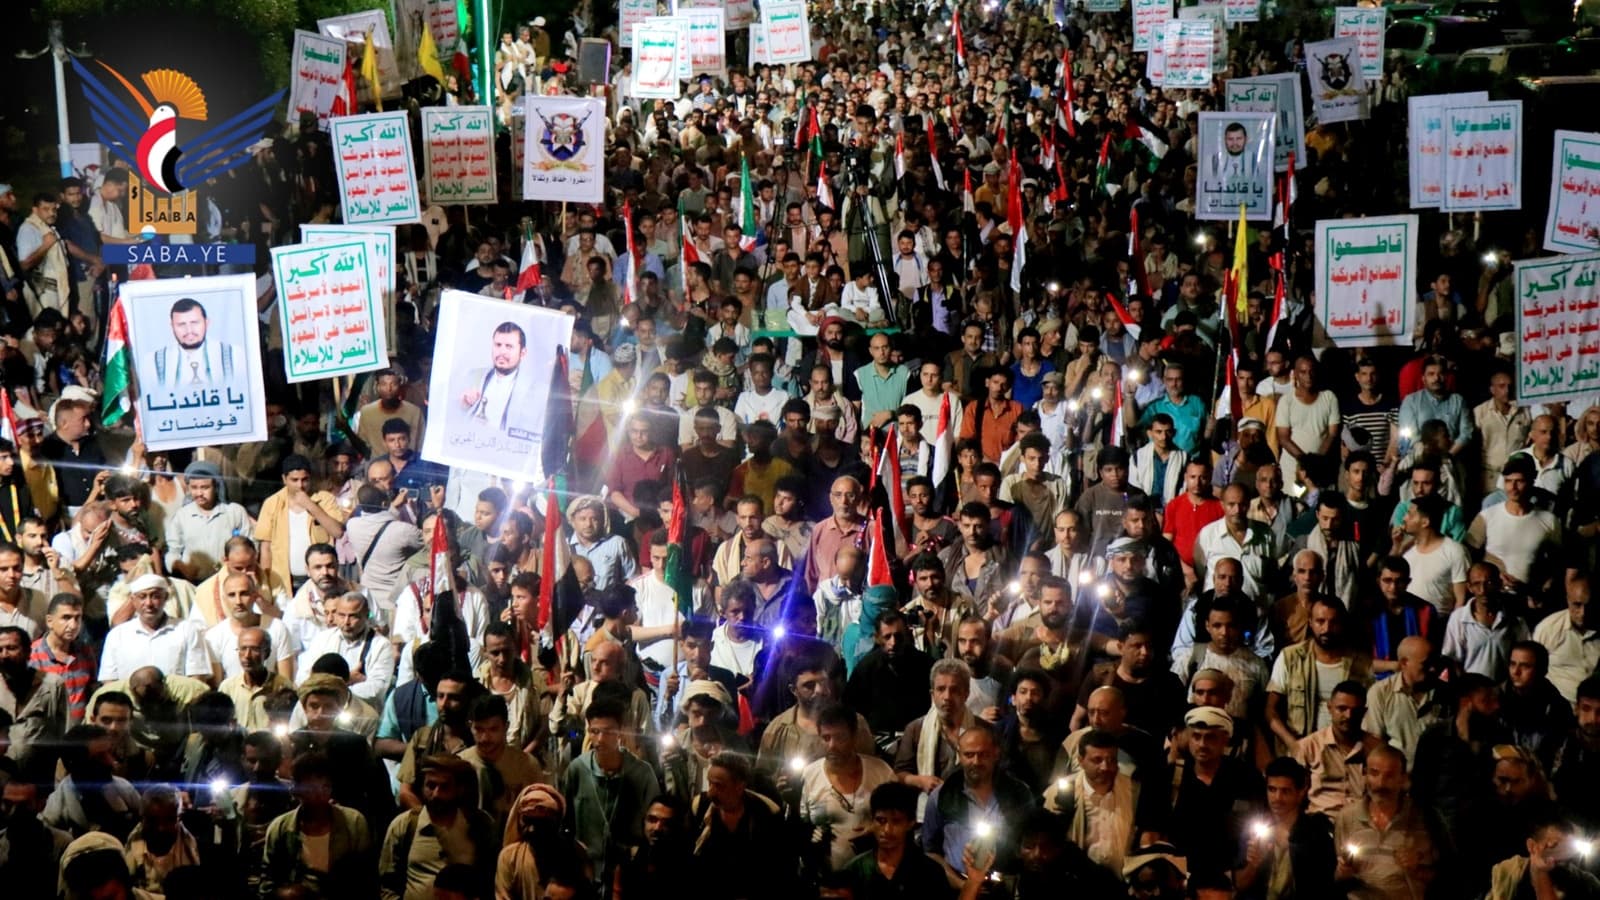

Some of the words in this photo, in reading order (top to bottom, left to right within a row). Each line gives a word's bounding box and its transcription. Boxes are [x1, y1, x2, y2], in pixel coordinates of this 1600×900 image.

[379, 122, 403, 139] الله
[431, 113, 464, 136] أكبر
[466, 115, 487, 130] الله
[1451, 112, 1512, 137] قاطعوا
[341, 122, 376, 148] أكبر
[1252, 181, 1264, 198] يا
[385, 195, 413, 217] النصر
[1331, 232, 1402, 262] قاطعوا
[286, 251, 330, 285] أكبر
[333, 251, 363, 272] الله
[331, 277, 365, 297] الموت
[1523, 266, 1573, 300] أكبر
[1361, 288, 1368, 304] و
[333, 299, 367, 317] الموت
[343, 320, 369, 335] اللعنة
[293, 343, 334, 368] للإسلام
[337, 337, 372, 365] النصر
[1523, 365, 1565, 392] للإسلام
[146, 388, 221, 412] قائدنا
[226, 386, 245, 411] يا
[157, 413, 238, 433] فوضناك
